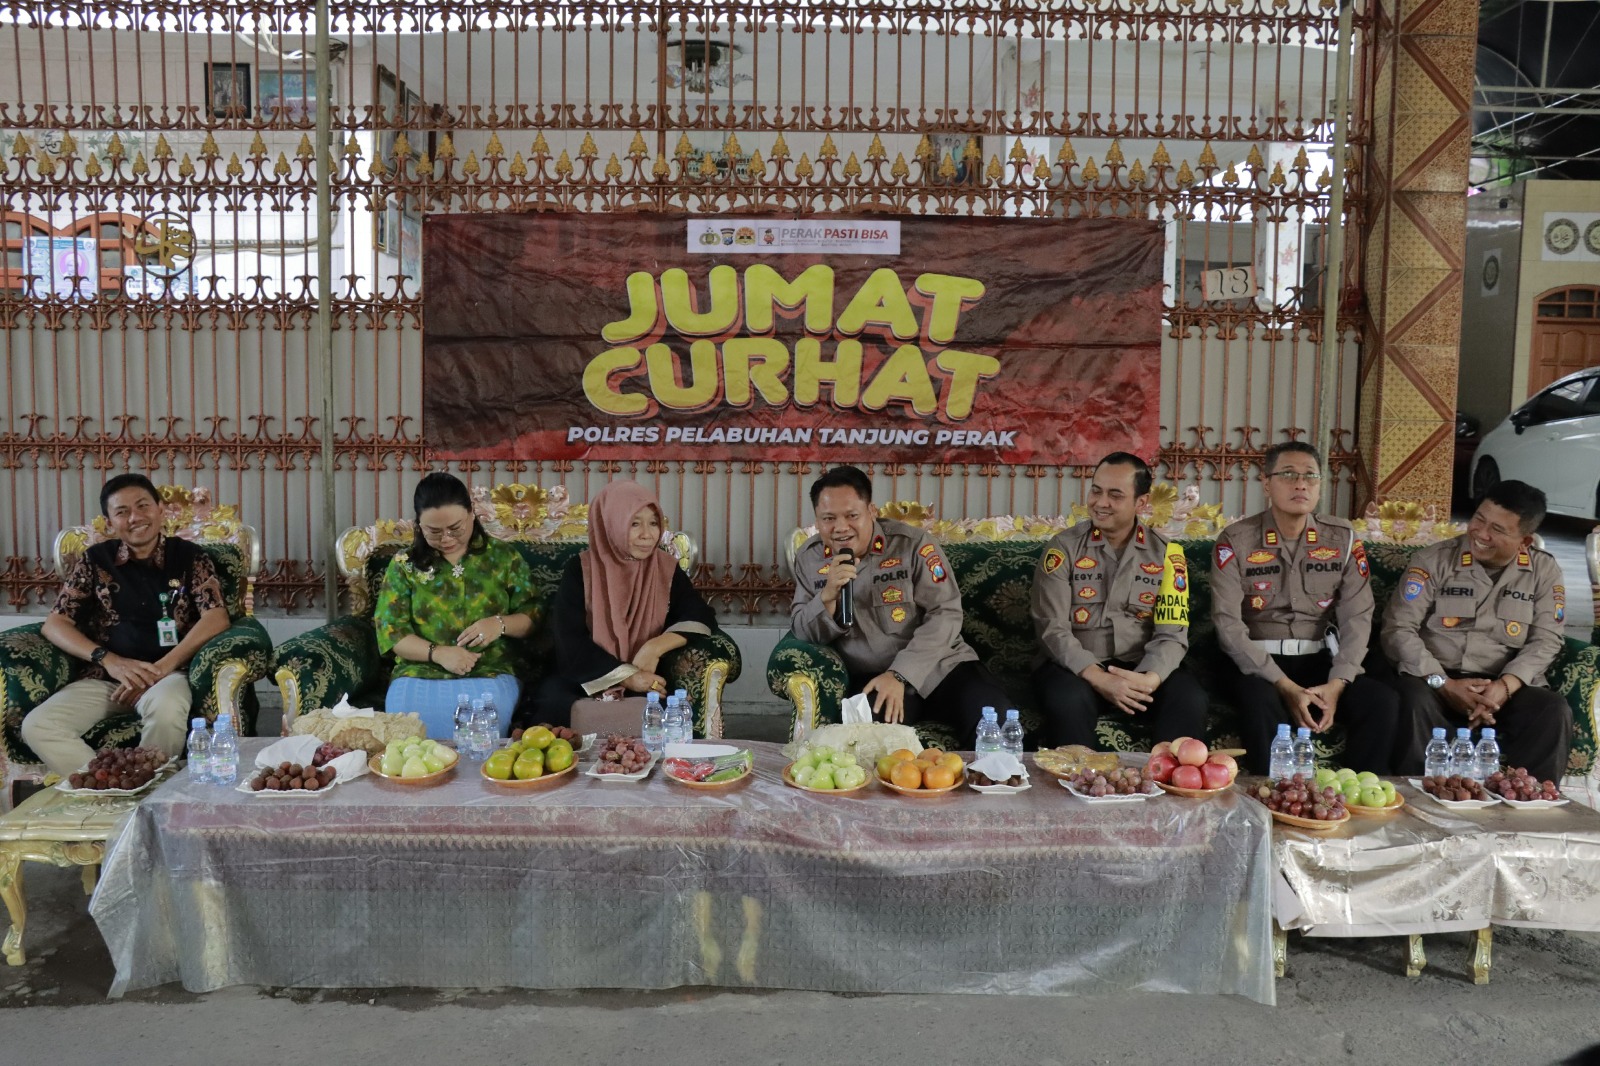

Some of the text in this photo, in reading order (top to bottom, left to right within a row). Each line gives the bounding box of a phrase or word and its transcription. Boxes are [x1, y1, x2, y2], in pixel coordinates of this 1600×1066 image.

[781, 228, 889, 240] PERAK PASTI BISA
[601, 263, 986, 345] JUMAT
[582, 338, 1000, 421] CURHAT
[567, 426, 1017, 447] POLRES PELABUHAN TANJUNG PERAK
[1306, 562, 1342, 573] POLRI
[873, 569, 909, 584] POLRI
[1134, 575, 1163, 587] POLR
[1440, 587, 1474, 597] HERI
[1503, 589, 1535, 602] POLR
[1155, 607, 1190, 621] WILAY
